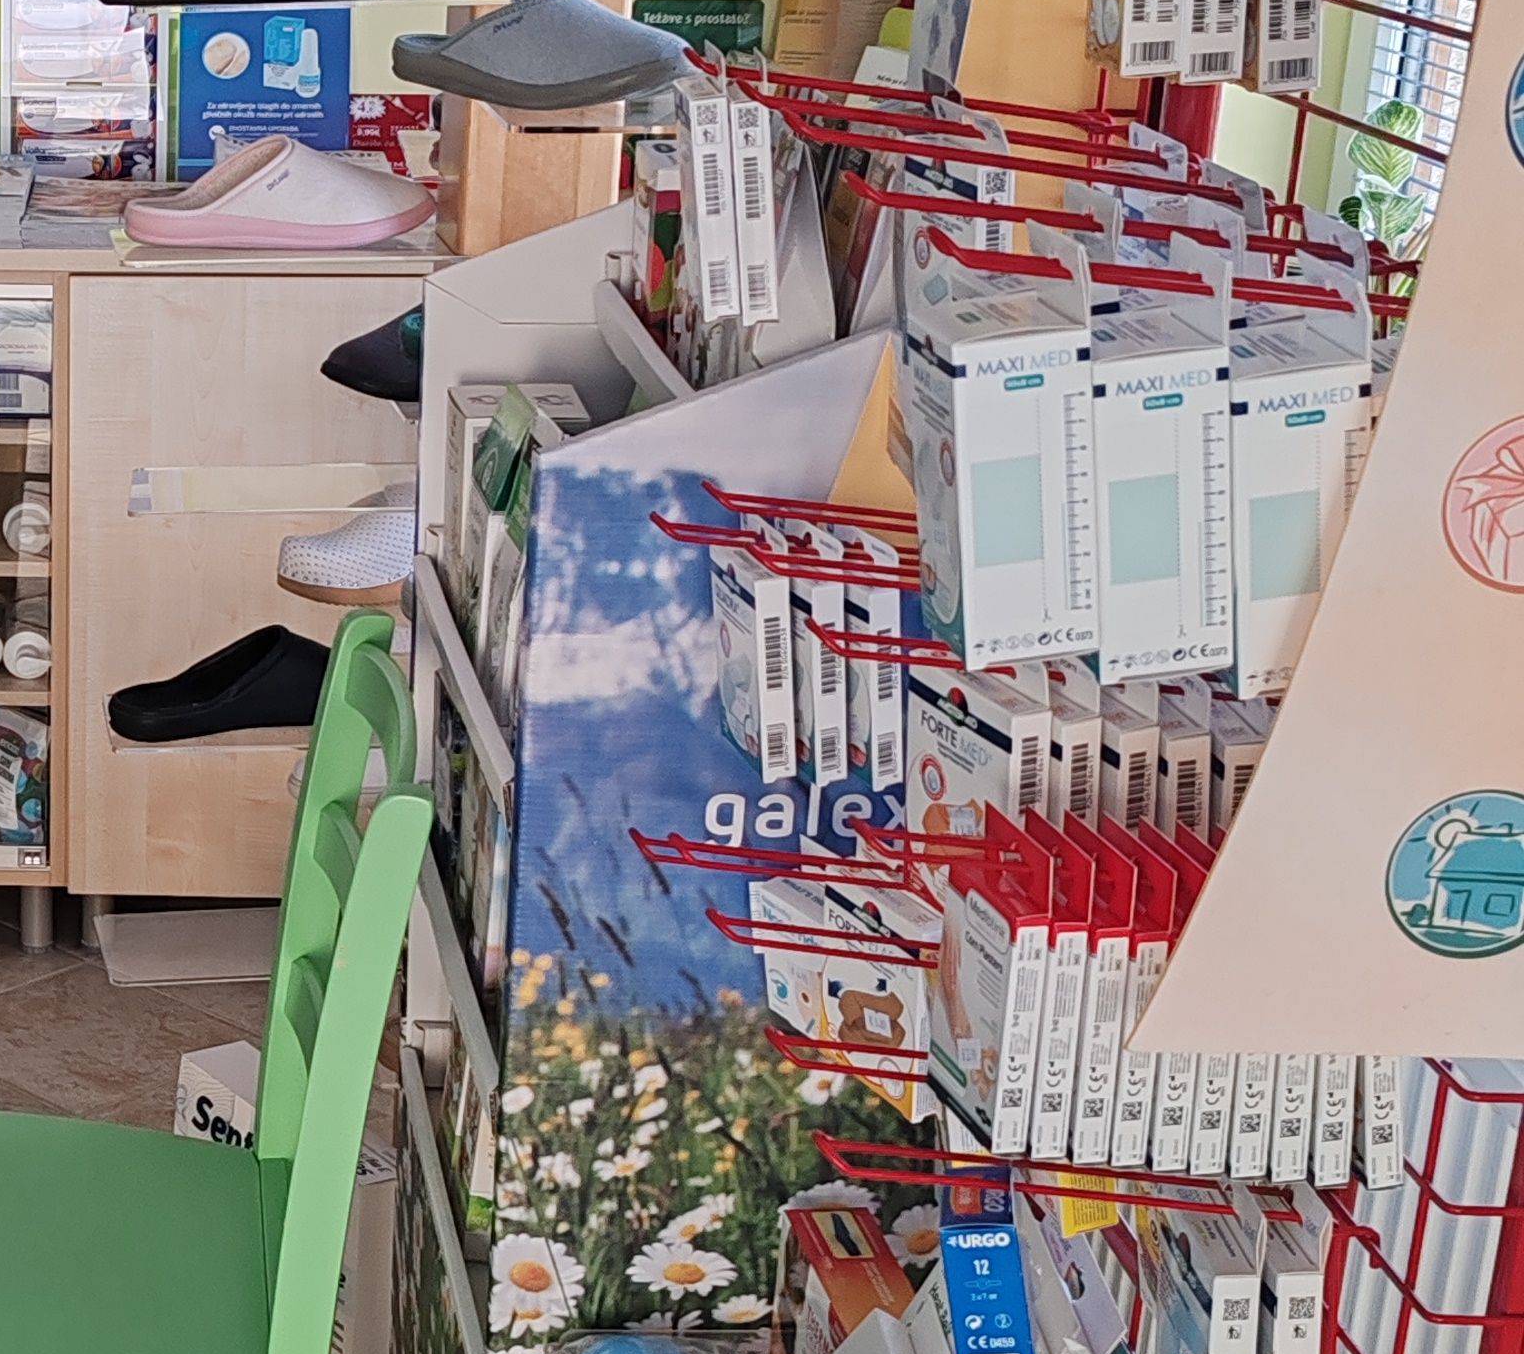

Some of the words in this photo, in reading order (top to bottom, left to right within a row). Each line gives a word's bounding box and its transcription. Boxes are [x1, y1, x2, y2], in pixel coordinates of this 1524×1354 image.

[643, 10, 681, 24] Težave
[684, 14, 691, 23] s
[694, 11, 751, 27] prostato?
[977, 357, 1024, 377] MAXI
[1031, 351, 1071, 369] MED
[1116, 377, 1164, 396] MAXI
[1169, 370, 1211, 389] MED
[1258, 393, 1307, 413] MAXI
[1311, 388, 1354, 405] MED
[921, 709, 958, 742] FORTE
[958, 1232, 1011, 1249] URGO
[974, 1259, 990, 1275] 12
[990, 1336, 1016, 1348] 0459
